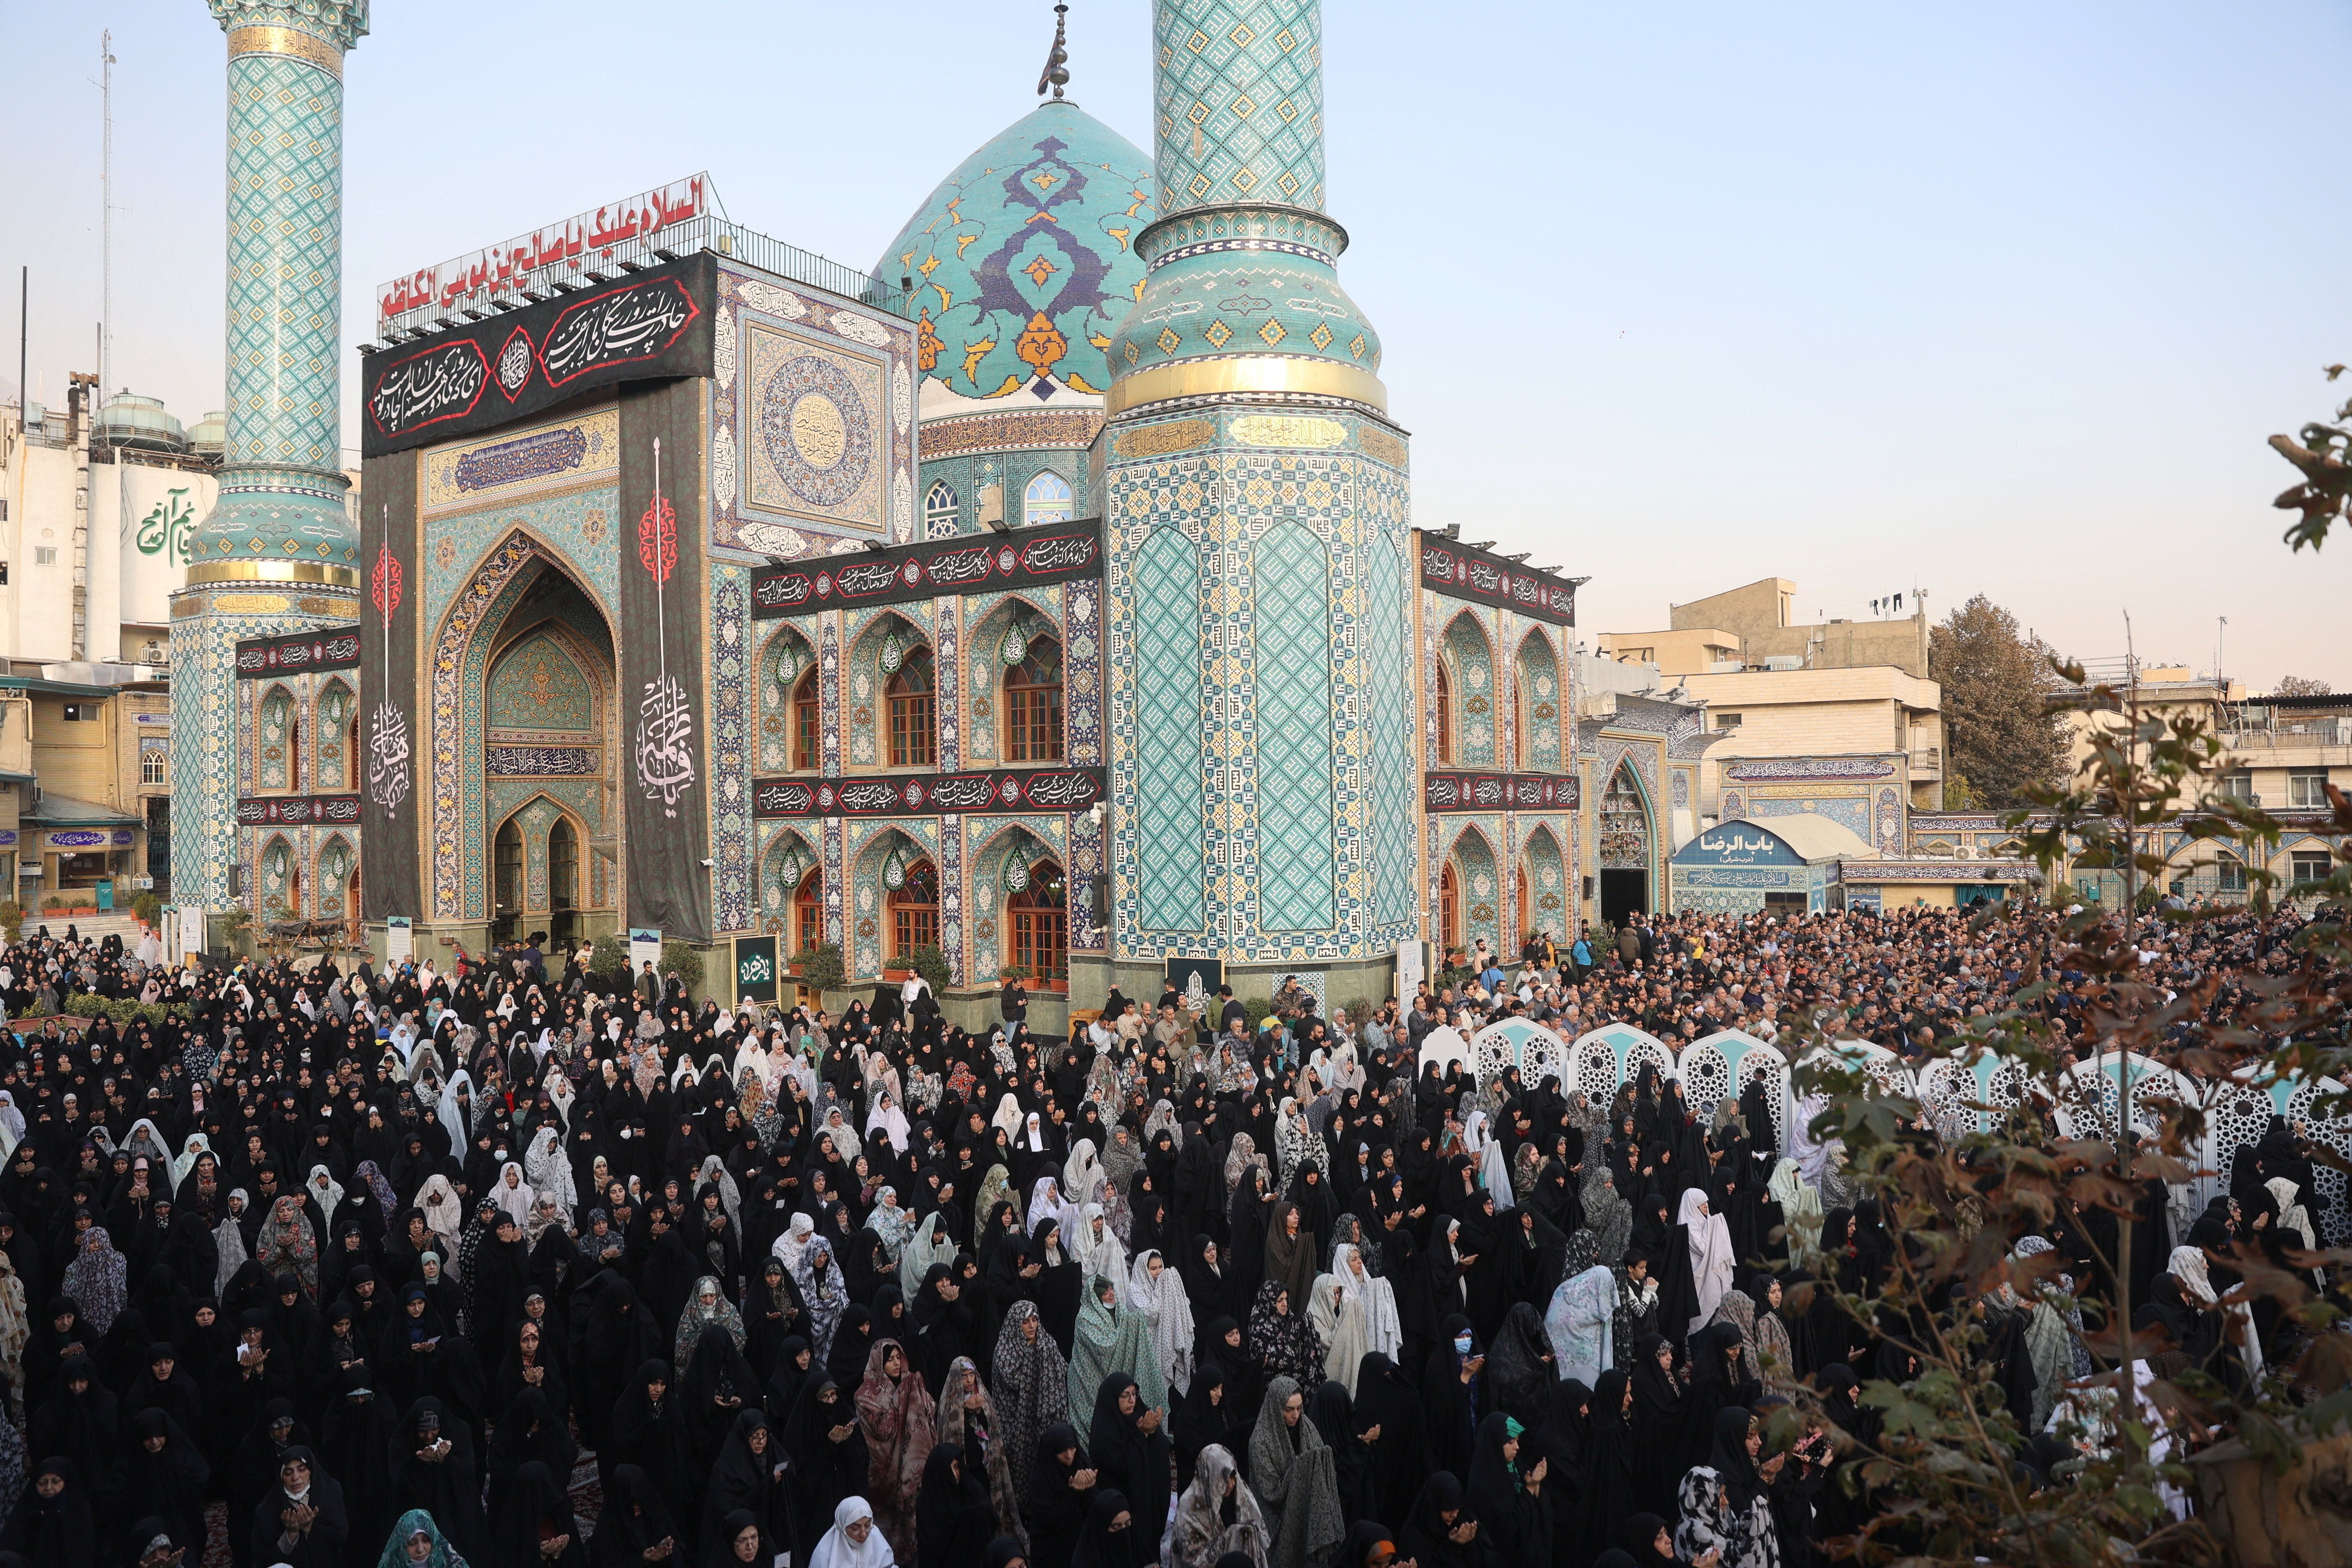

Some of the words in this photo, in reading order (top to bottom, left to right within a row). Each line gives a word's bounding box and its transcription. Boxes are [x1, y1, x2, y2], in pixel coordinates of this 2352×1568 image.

[640, 175, 704, 248] السلام
[513, 230, 566, 288] صالح
[566, 220, 585, 269] یا
[441, 259, 489, 308] موسی
[489, 248, 514, 293] بن
[382, 266, 438, 331] الکاظم
[1701, 835, 1743, 855] الرضا
[1745, 835, 1774, 855] باب
